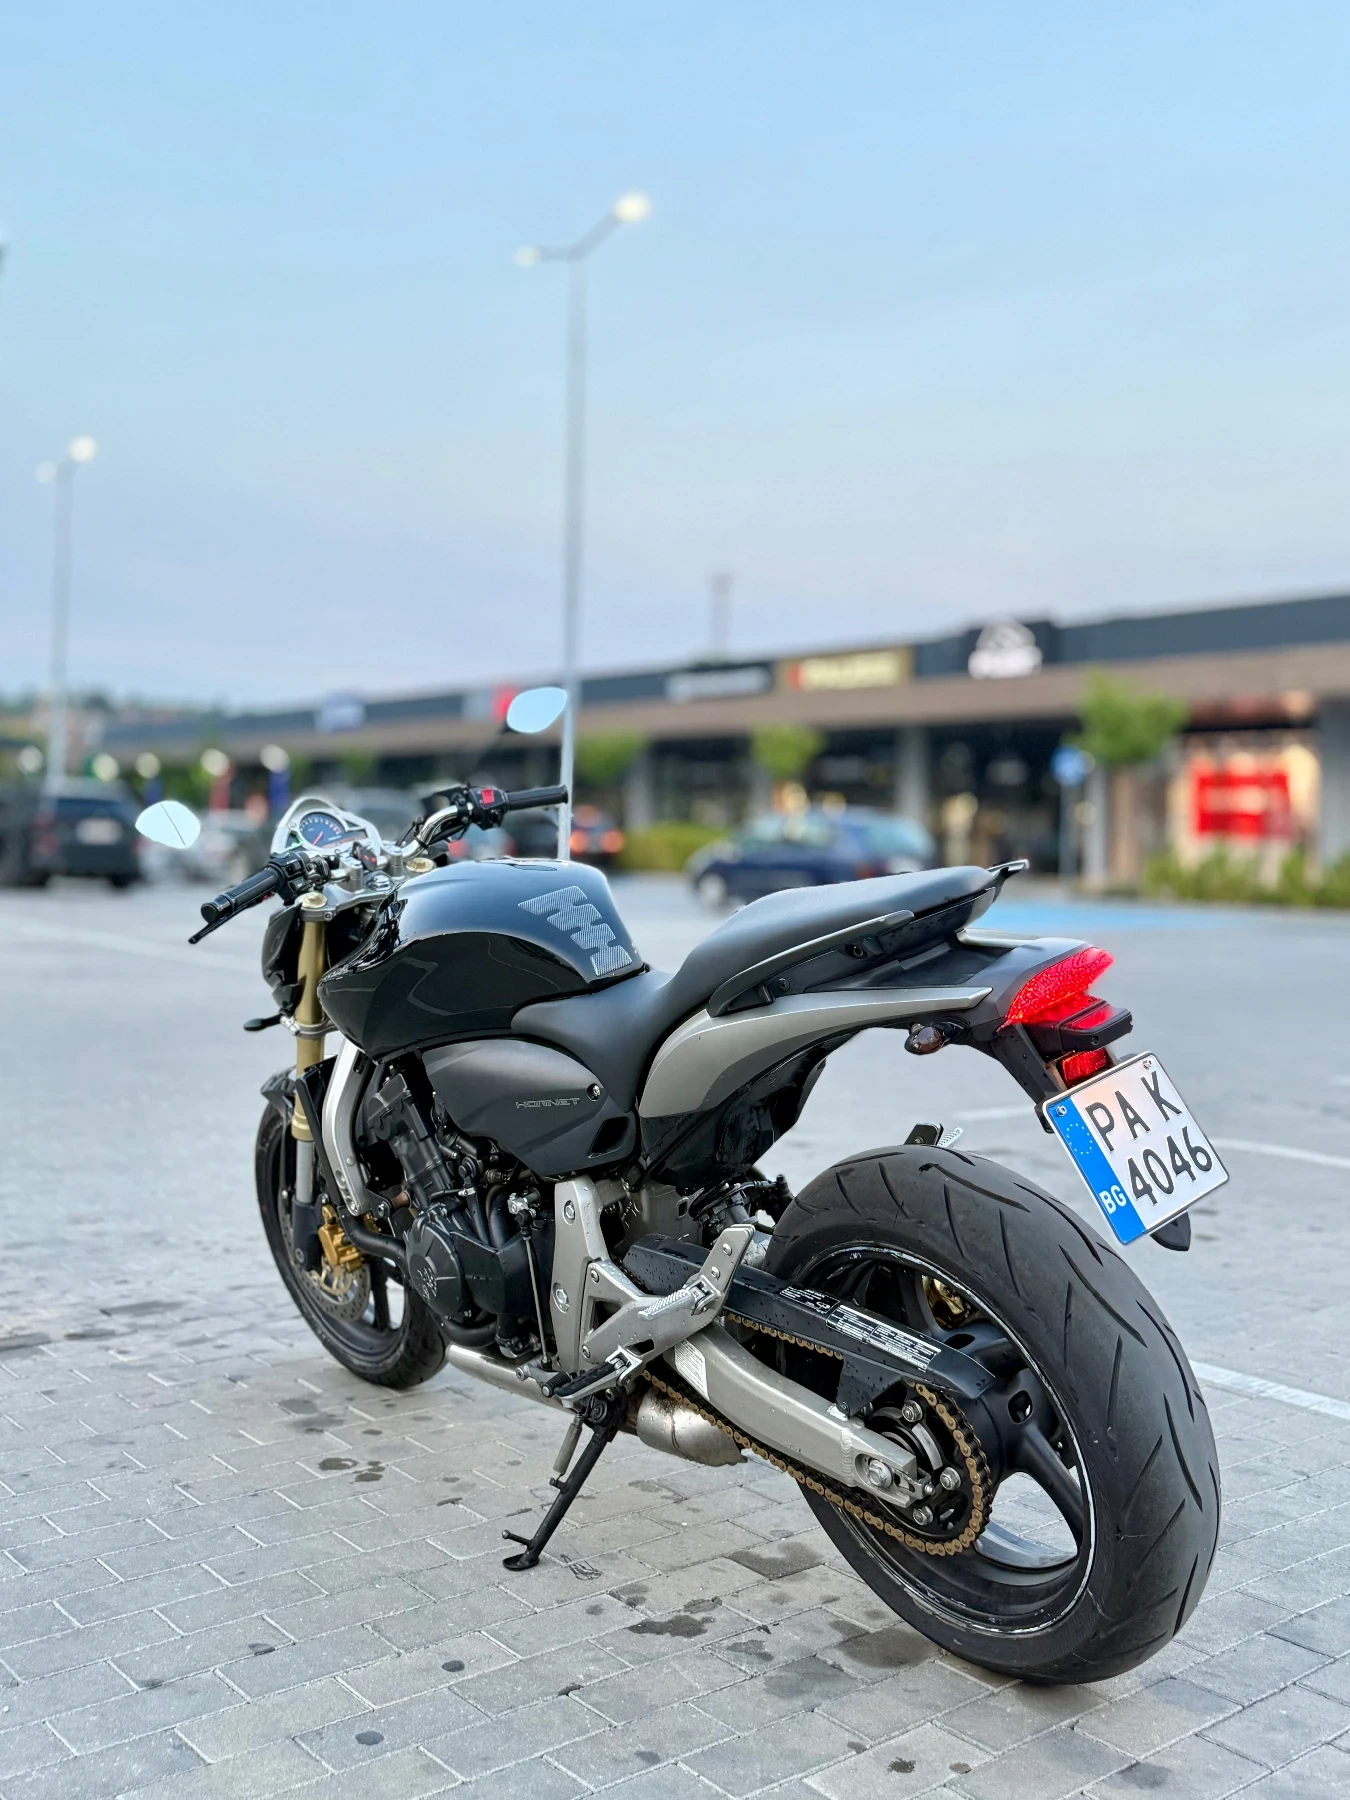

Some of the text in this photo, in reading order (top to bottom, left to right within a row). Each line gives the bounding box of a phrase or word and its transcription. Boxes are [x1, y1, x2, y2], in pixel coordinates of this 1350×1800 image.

[515, 1097, 580, 1109] HORNET
[1127, 1126, 1213, 1206] 4046
[1098, 1185, 1127, 1215] BG
